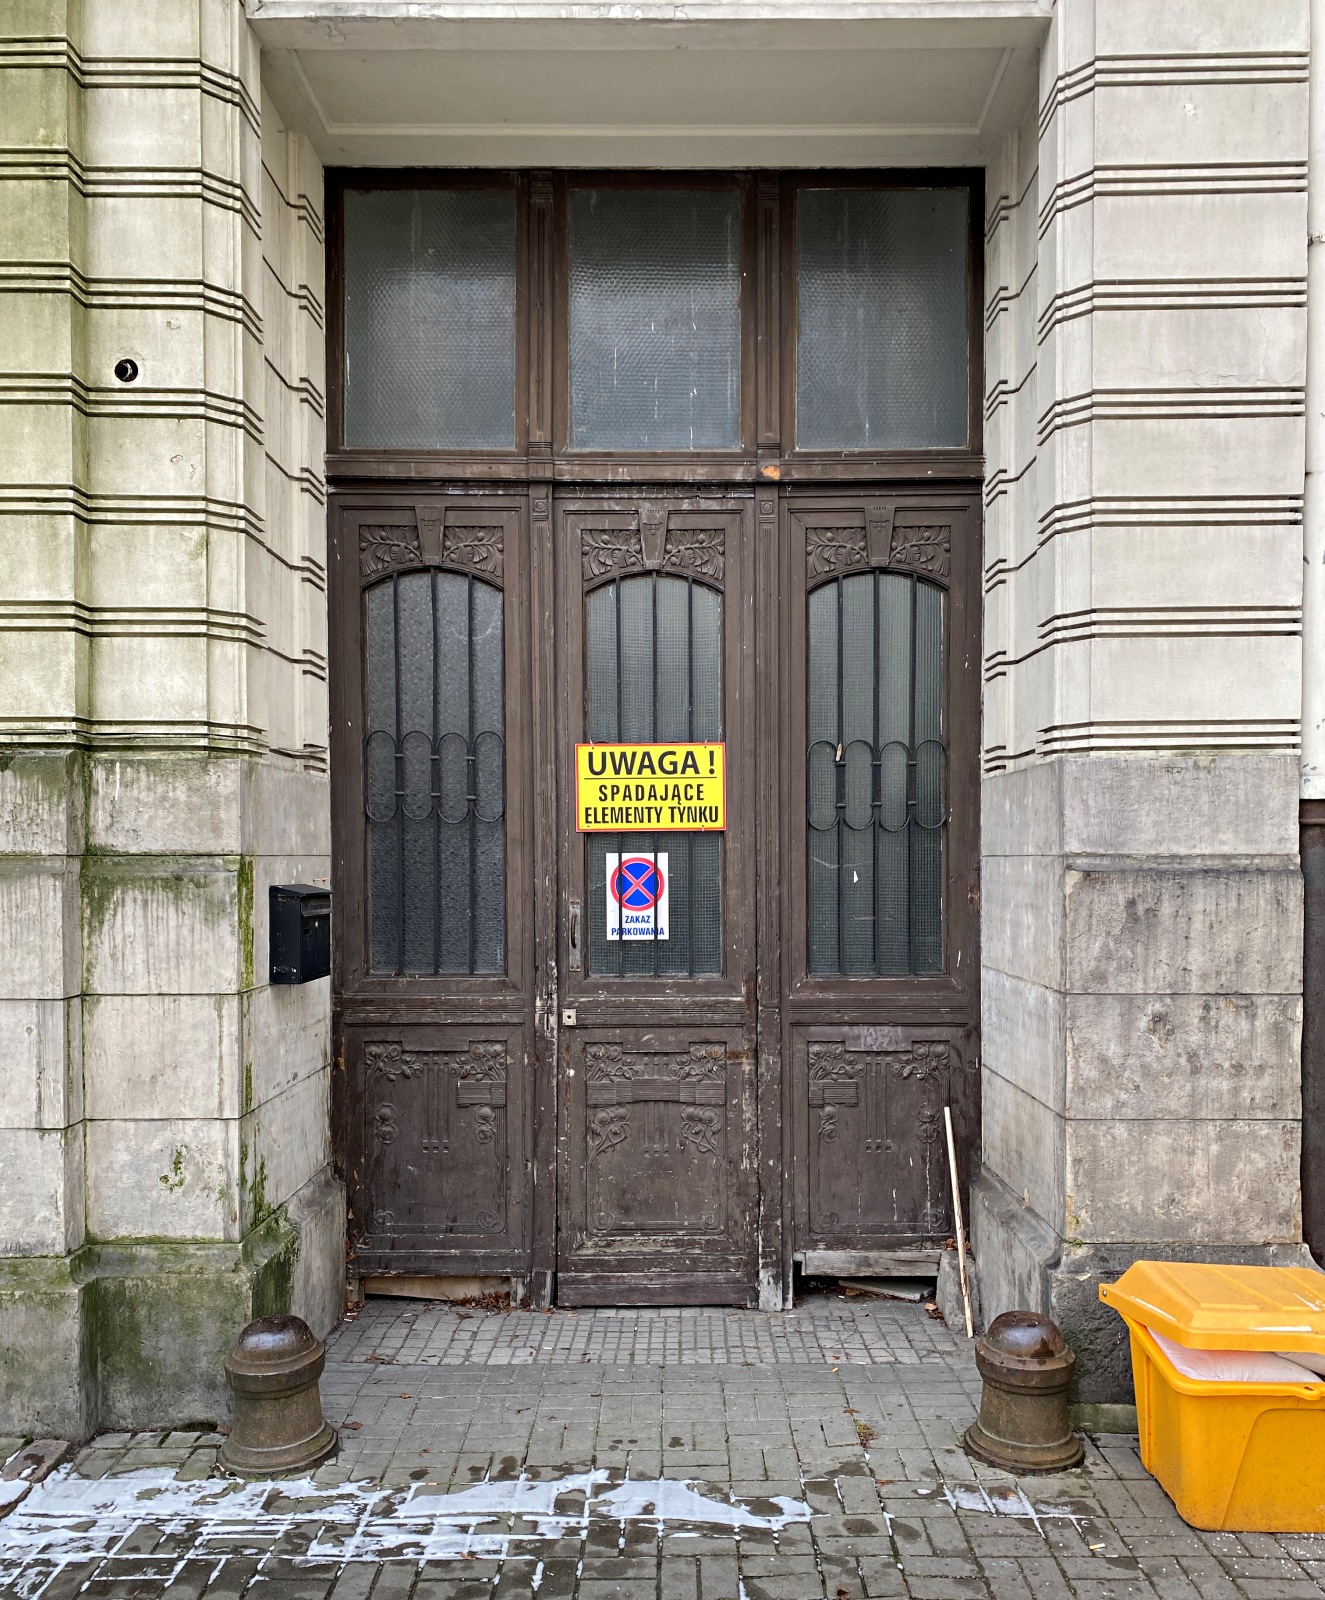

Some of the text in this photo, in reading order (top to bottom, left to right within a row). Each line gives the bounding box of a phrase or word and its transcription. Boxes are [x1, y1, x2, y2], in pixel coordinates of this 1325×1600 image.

[588, 750, 716, 775] UWAGA !
[598, 784, 704, 804] SPADAJĄCE
[584, 805, 719, 824] ELEMENTY TYNKU
[624, 915, 651, 924] ZAKAZ
